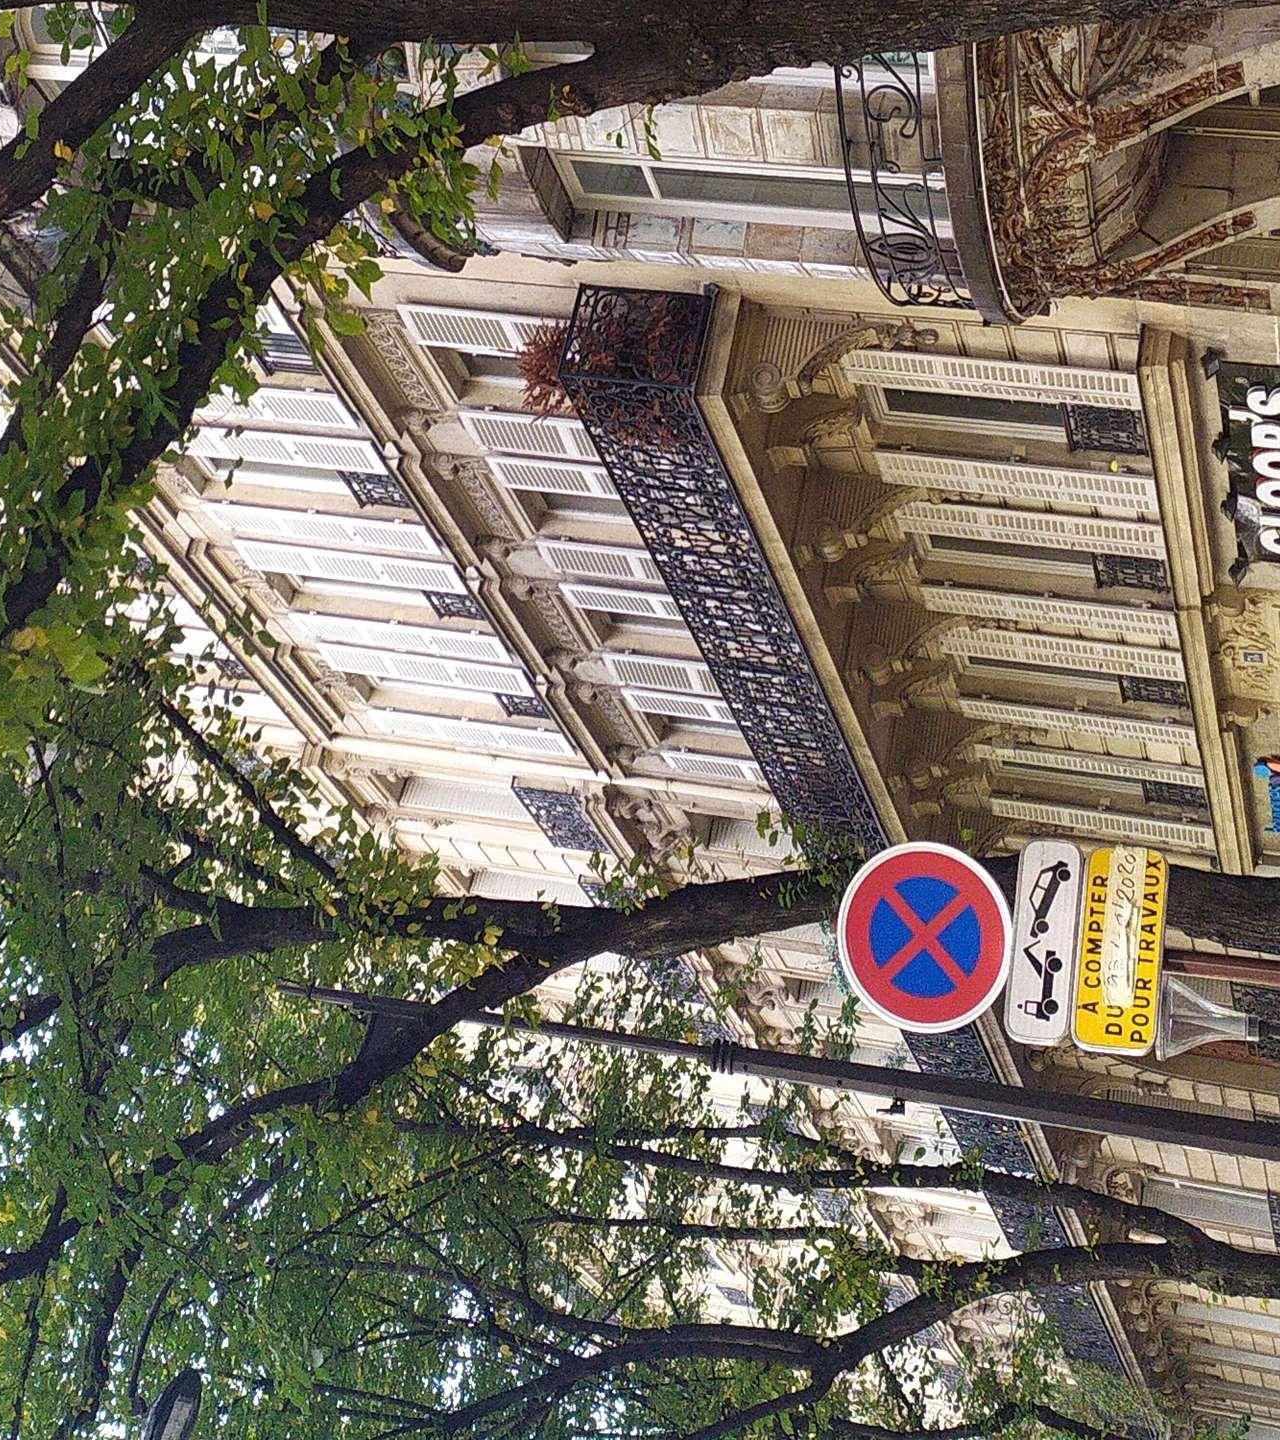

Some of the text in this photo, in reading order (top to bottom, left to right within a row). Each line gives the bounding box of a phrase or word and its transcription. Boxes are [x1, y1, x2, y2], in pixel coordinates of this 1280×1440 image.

[1078, 874, 1109, 1015] À COMPTER
[1130, 858, 1162, 1044] POUR TRAVAUX
[1105, 1005, 1124, 1036] DU
